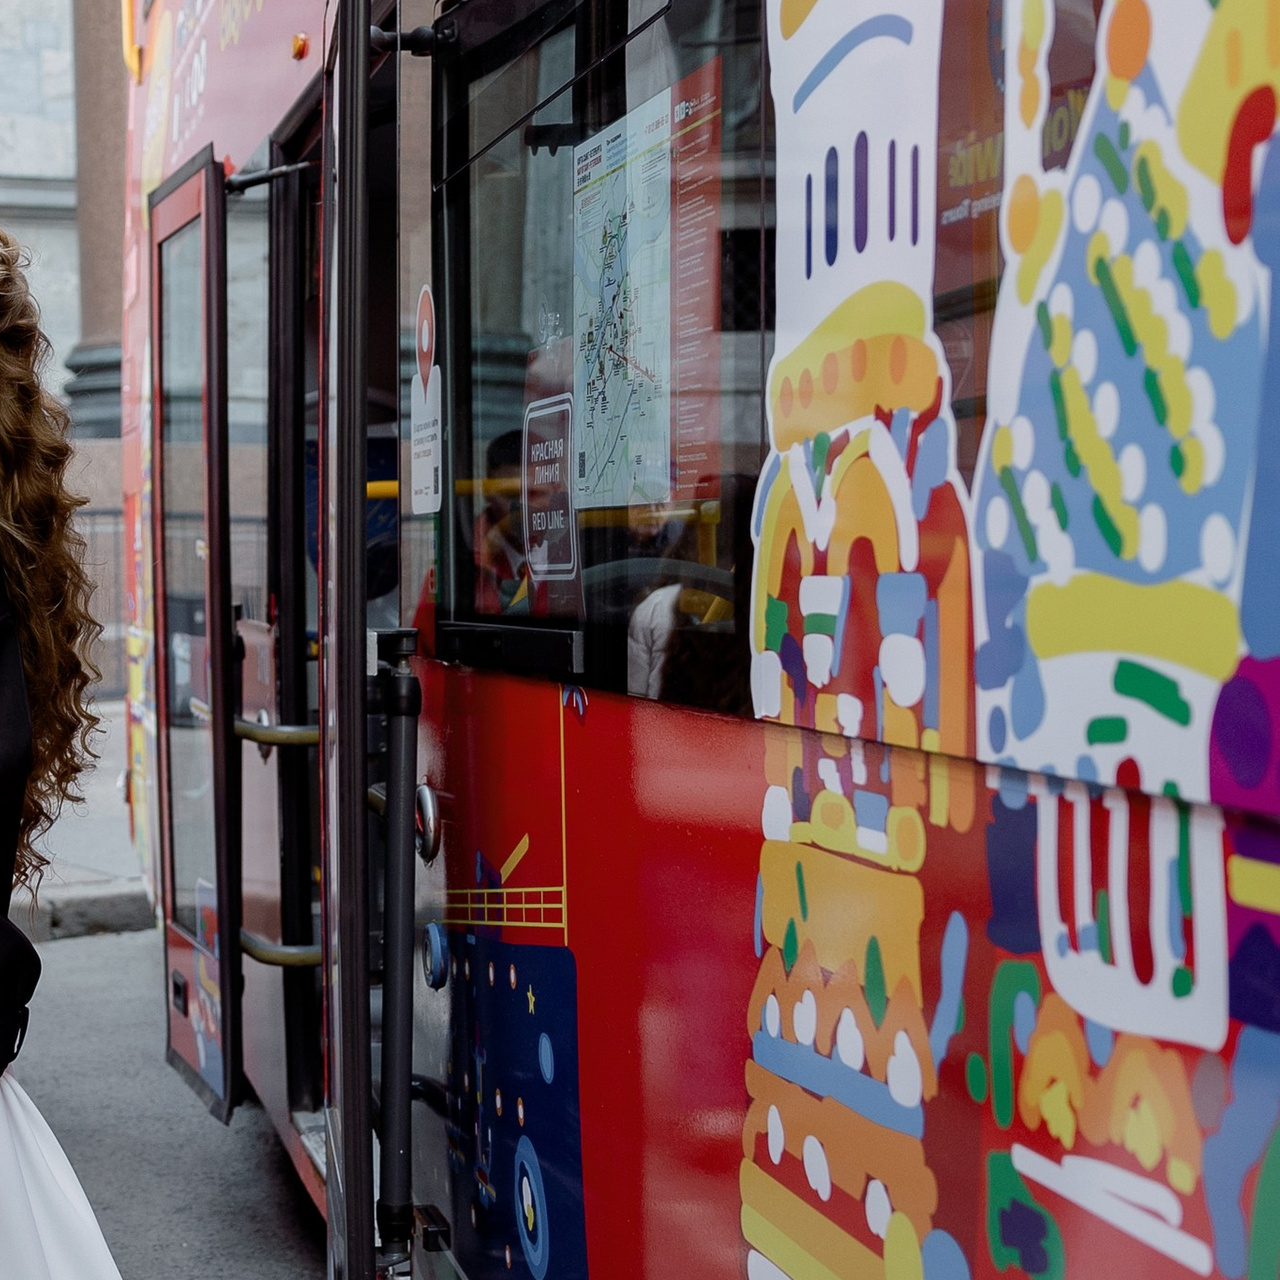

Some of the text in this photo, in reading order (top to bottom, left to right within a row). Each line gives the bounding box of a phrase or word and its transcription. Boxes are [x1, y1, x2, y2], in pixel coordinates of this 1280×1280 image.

[531, 438, 563, 462] КРАСНАЯ
[534, 463, 560, 485] ЛИНИЯ
[532, 509, 565, 531] RED LINE
